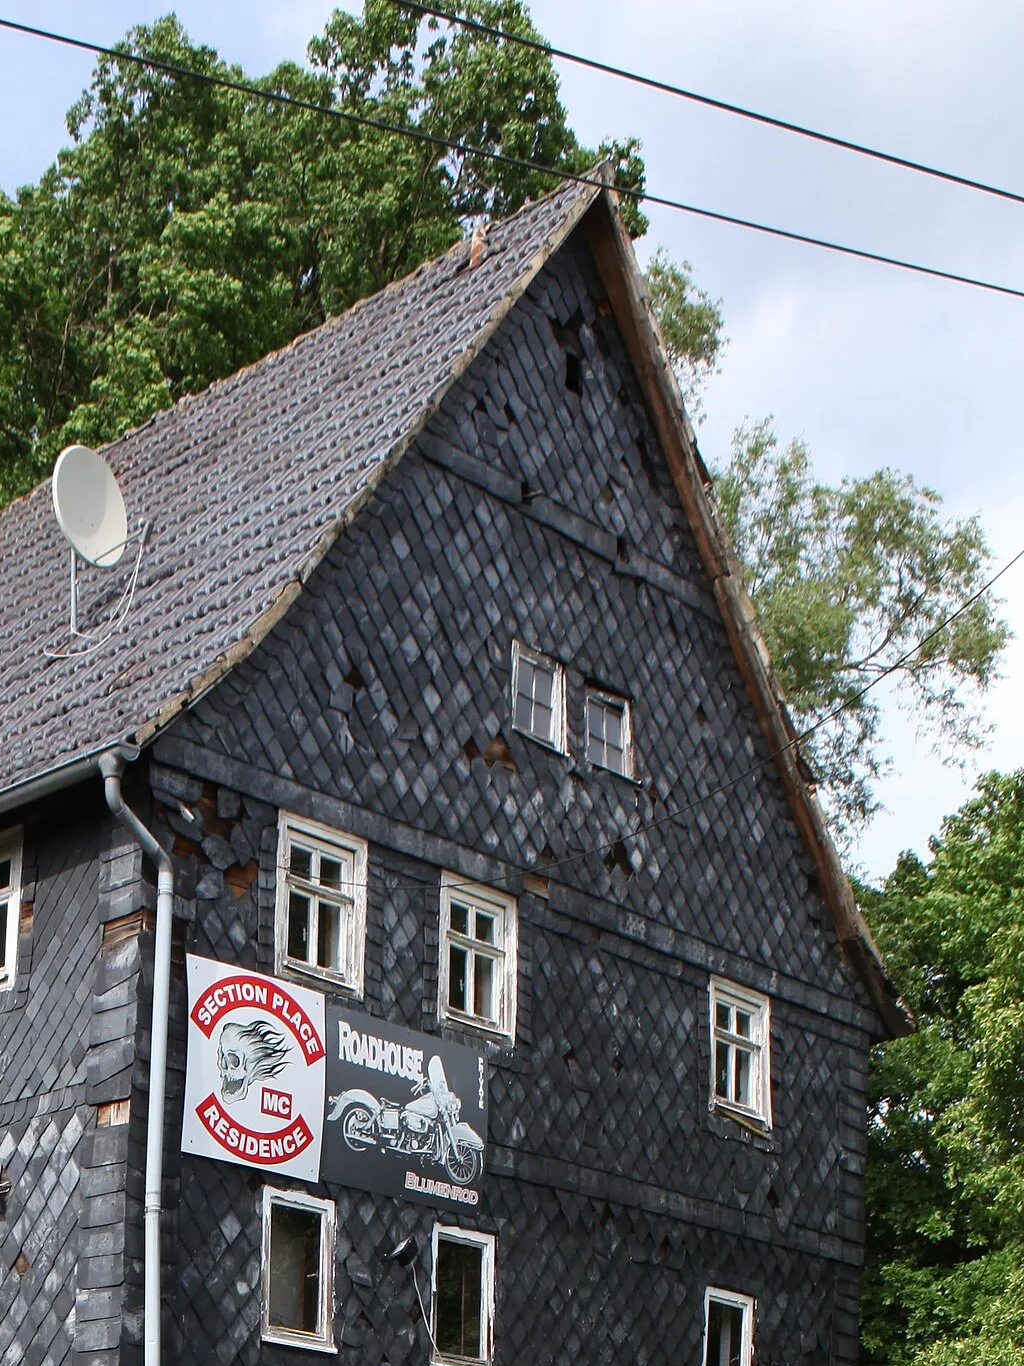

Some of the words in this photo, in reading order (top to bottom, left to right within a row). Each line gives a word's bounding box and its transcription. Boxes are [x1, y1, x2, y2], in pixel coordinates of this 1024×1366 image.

[198, 983, 268, 1027] SECTION
[272, 995, 321, 1056] PLACE
[338, 1020, 423, 1081] ROADHOUSE
[203, 1104, 308, 1159] RESIDENCE
[263, 1092, 291, 1116] MC
[405, 1172, 478, 1205] BLUMENROD
